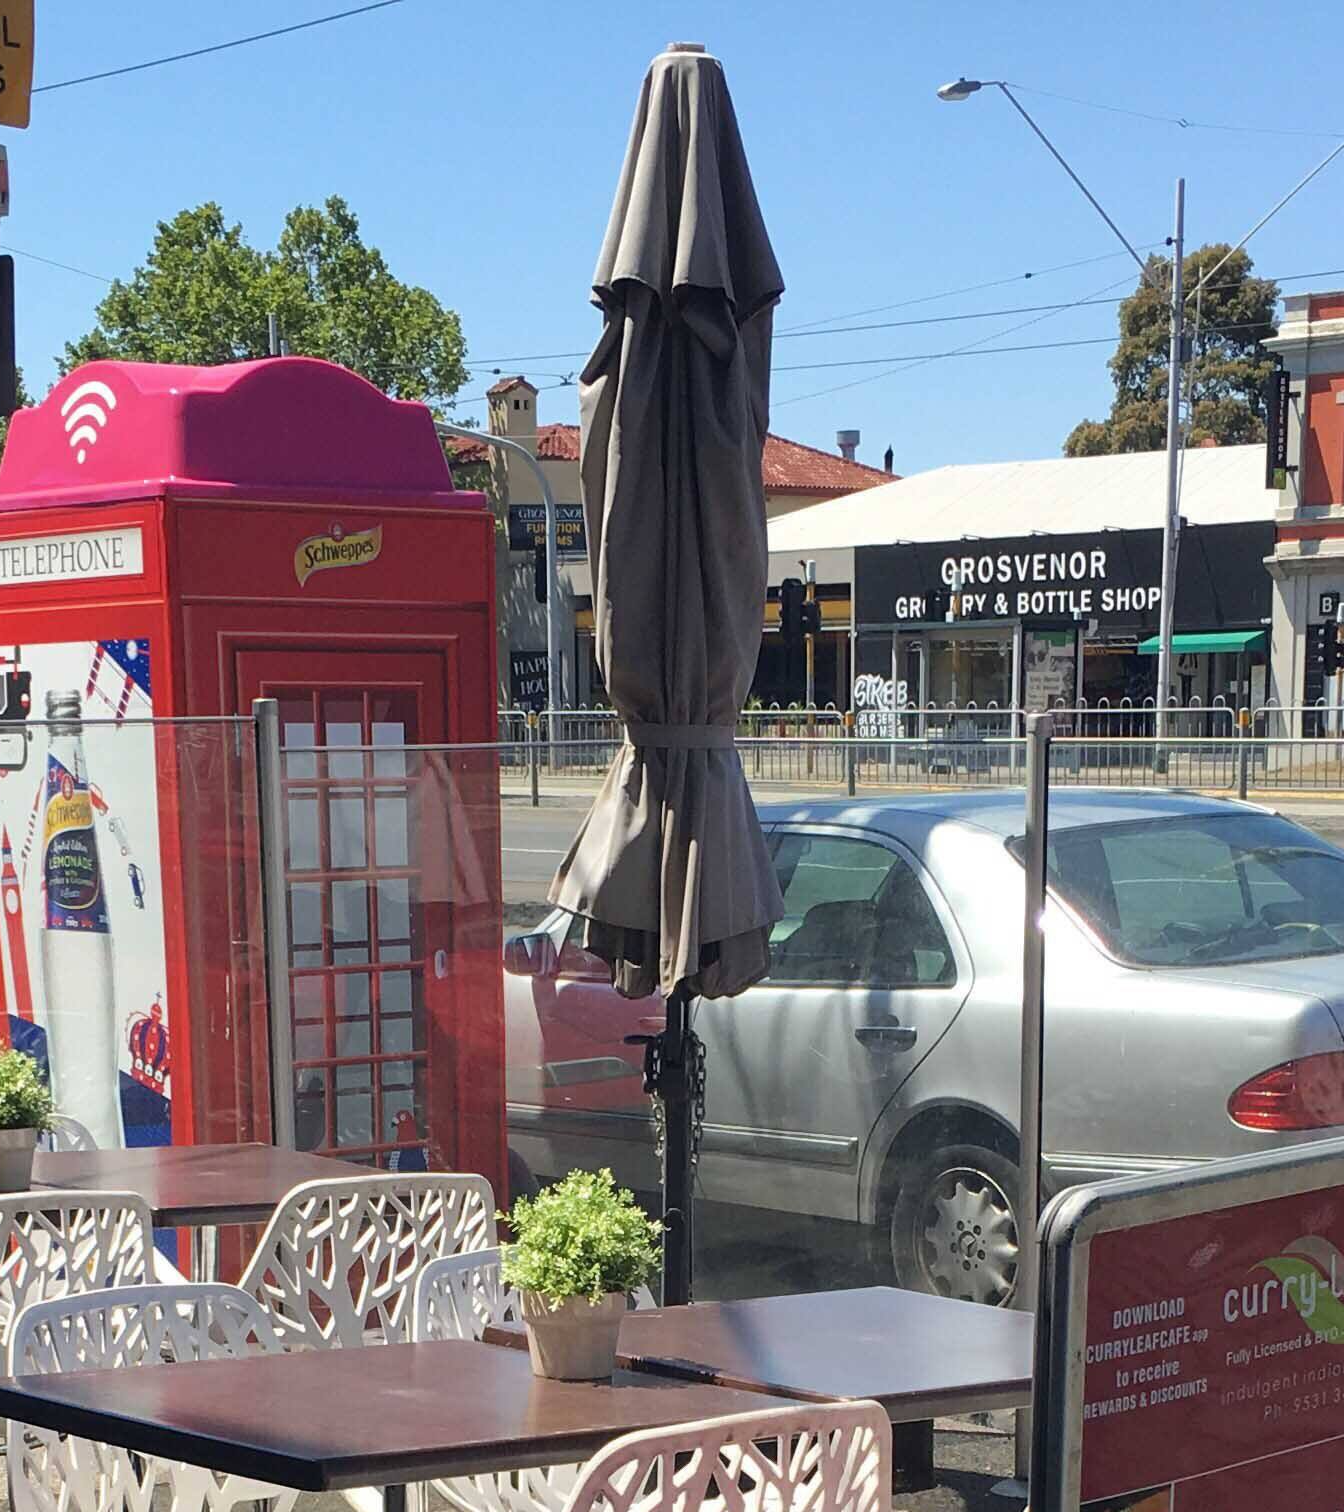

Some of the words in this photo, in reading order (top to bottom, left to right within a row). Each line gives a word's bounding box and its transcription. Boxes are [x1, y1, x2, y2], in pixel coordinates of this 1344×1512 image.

[302, 541, 374, 569] Schweppes
[941, 550, 1107, 585] GROSVENOR
[895, 593, 987, 619] GRRY
[994, 592, 1009, 615] &
[1016, 590, 1093, 616] BOTTLE
[1101, 586, 1161, 612] SHOP
[1112, 1297, 1185, 1329] DOWNLOAD
[1086, 1325, 1191, 1364] CURRYLEAFCAFE
[1192, 1328, 1209, 1343] app
[1226, 1348, 1252, 1367] Fully
[1253, 1336, 1302, 1360] Licensed
[1305, 1333, 1312, 1347] &
[1116, 1370, 1129, 1388] to
[1133, 1360, 1180, 1385] receive
[1221, 1373, 1298, 1406] indulgent
[1083, 1394, 1137, 1420] REWARDS
[1138, 1391, 1148, 1408] &
[1150, 1377, 1208, 1405] DISCOUNTS
[1293, 1391, 1327, 1413] 9531
